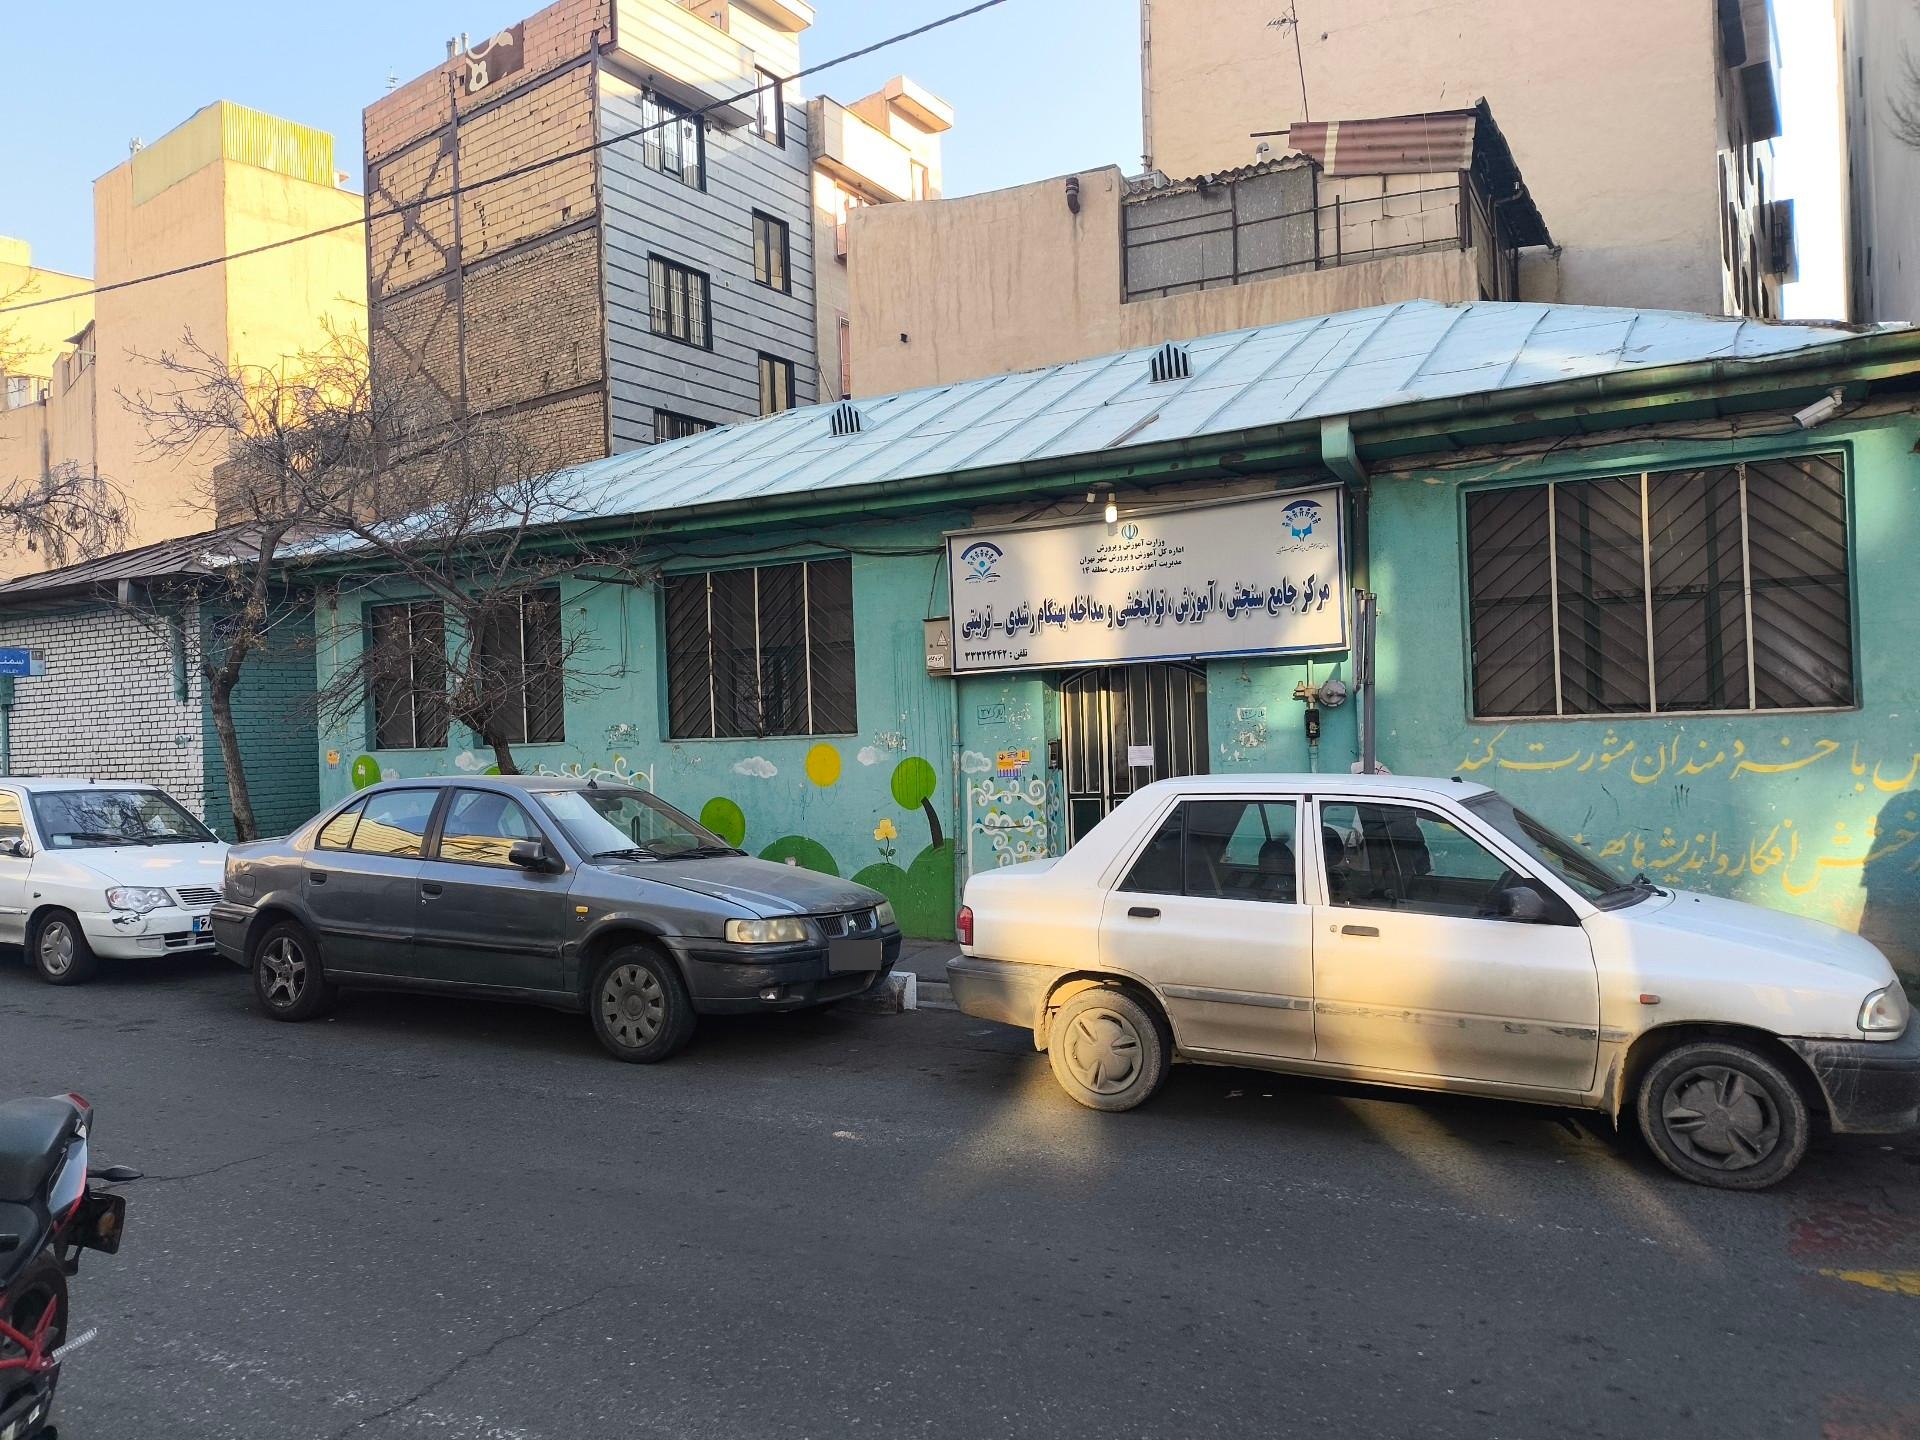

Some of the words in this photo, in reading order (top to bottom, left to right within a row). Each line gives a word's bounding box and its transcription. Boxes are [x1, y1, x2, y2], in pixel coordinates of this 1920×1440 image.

[1096, 544, 1117, 553] پرورش
[1123, 539, 1144, 550] آموزش
[1146, 538, 1165, 548] وزارت
[1135, 549, 1156, 560] آموزش
[1158, 548, 1167, 557] کل
[1169, 546, 1184, 556] اداره
[1079, 556, 1096, 565] تهران
[1096, 554, 1107, 563] شهر
[1108, 553, 1129, 562] پرورش
[1082, 566, 1090, 574] ۱۴
[1109, 565, 1130, 573] پرورش
[1136, 560, 1157, 571] آموزش
[1159, 559, 1182, 569] مدیریت
[1267, 575, 1298, 617] جامع
[1301, 574, 1330, 613] مرکز
[1069, 595, 1104, 622] مداخله
[1115, 588, 1166, 627] توانبخشی
[962, 604, 993, 639] تربیتی
[1005, 601, 1035, 636] رشدی
[1037, 598, 1067, 633] بهنگام
[1106, 603, 1113, 629] و
[964, 648, 1007, 662] ۳۳۳۲۴۲۴۲
[1454, 725, 1510, 772] کند
[1498, 728, 1635, 773] مشورت
[1850, 740, 1867, 793] با
[1727, 818, 1799, 877] افکار
